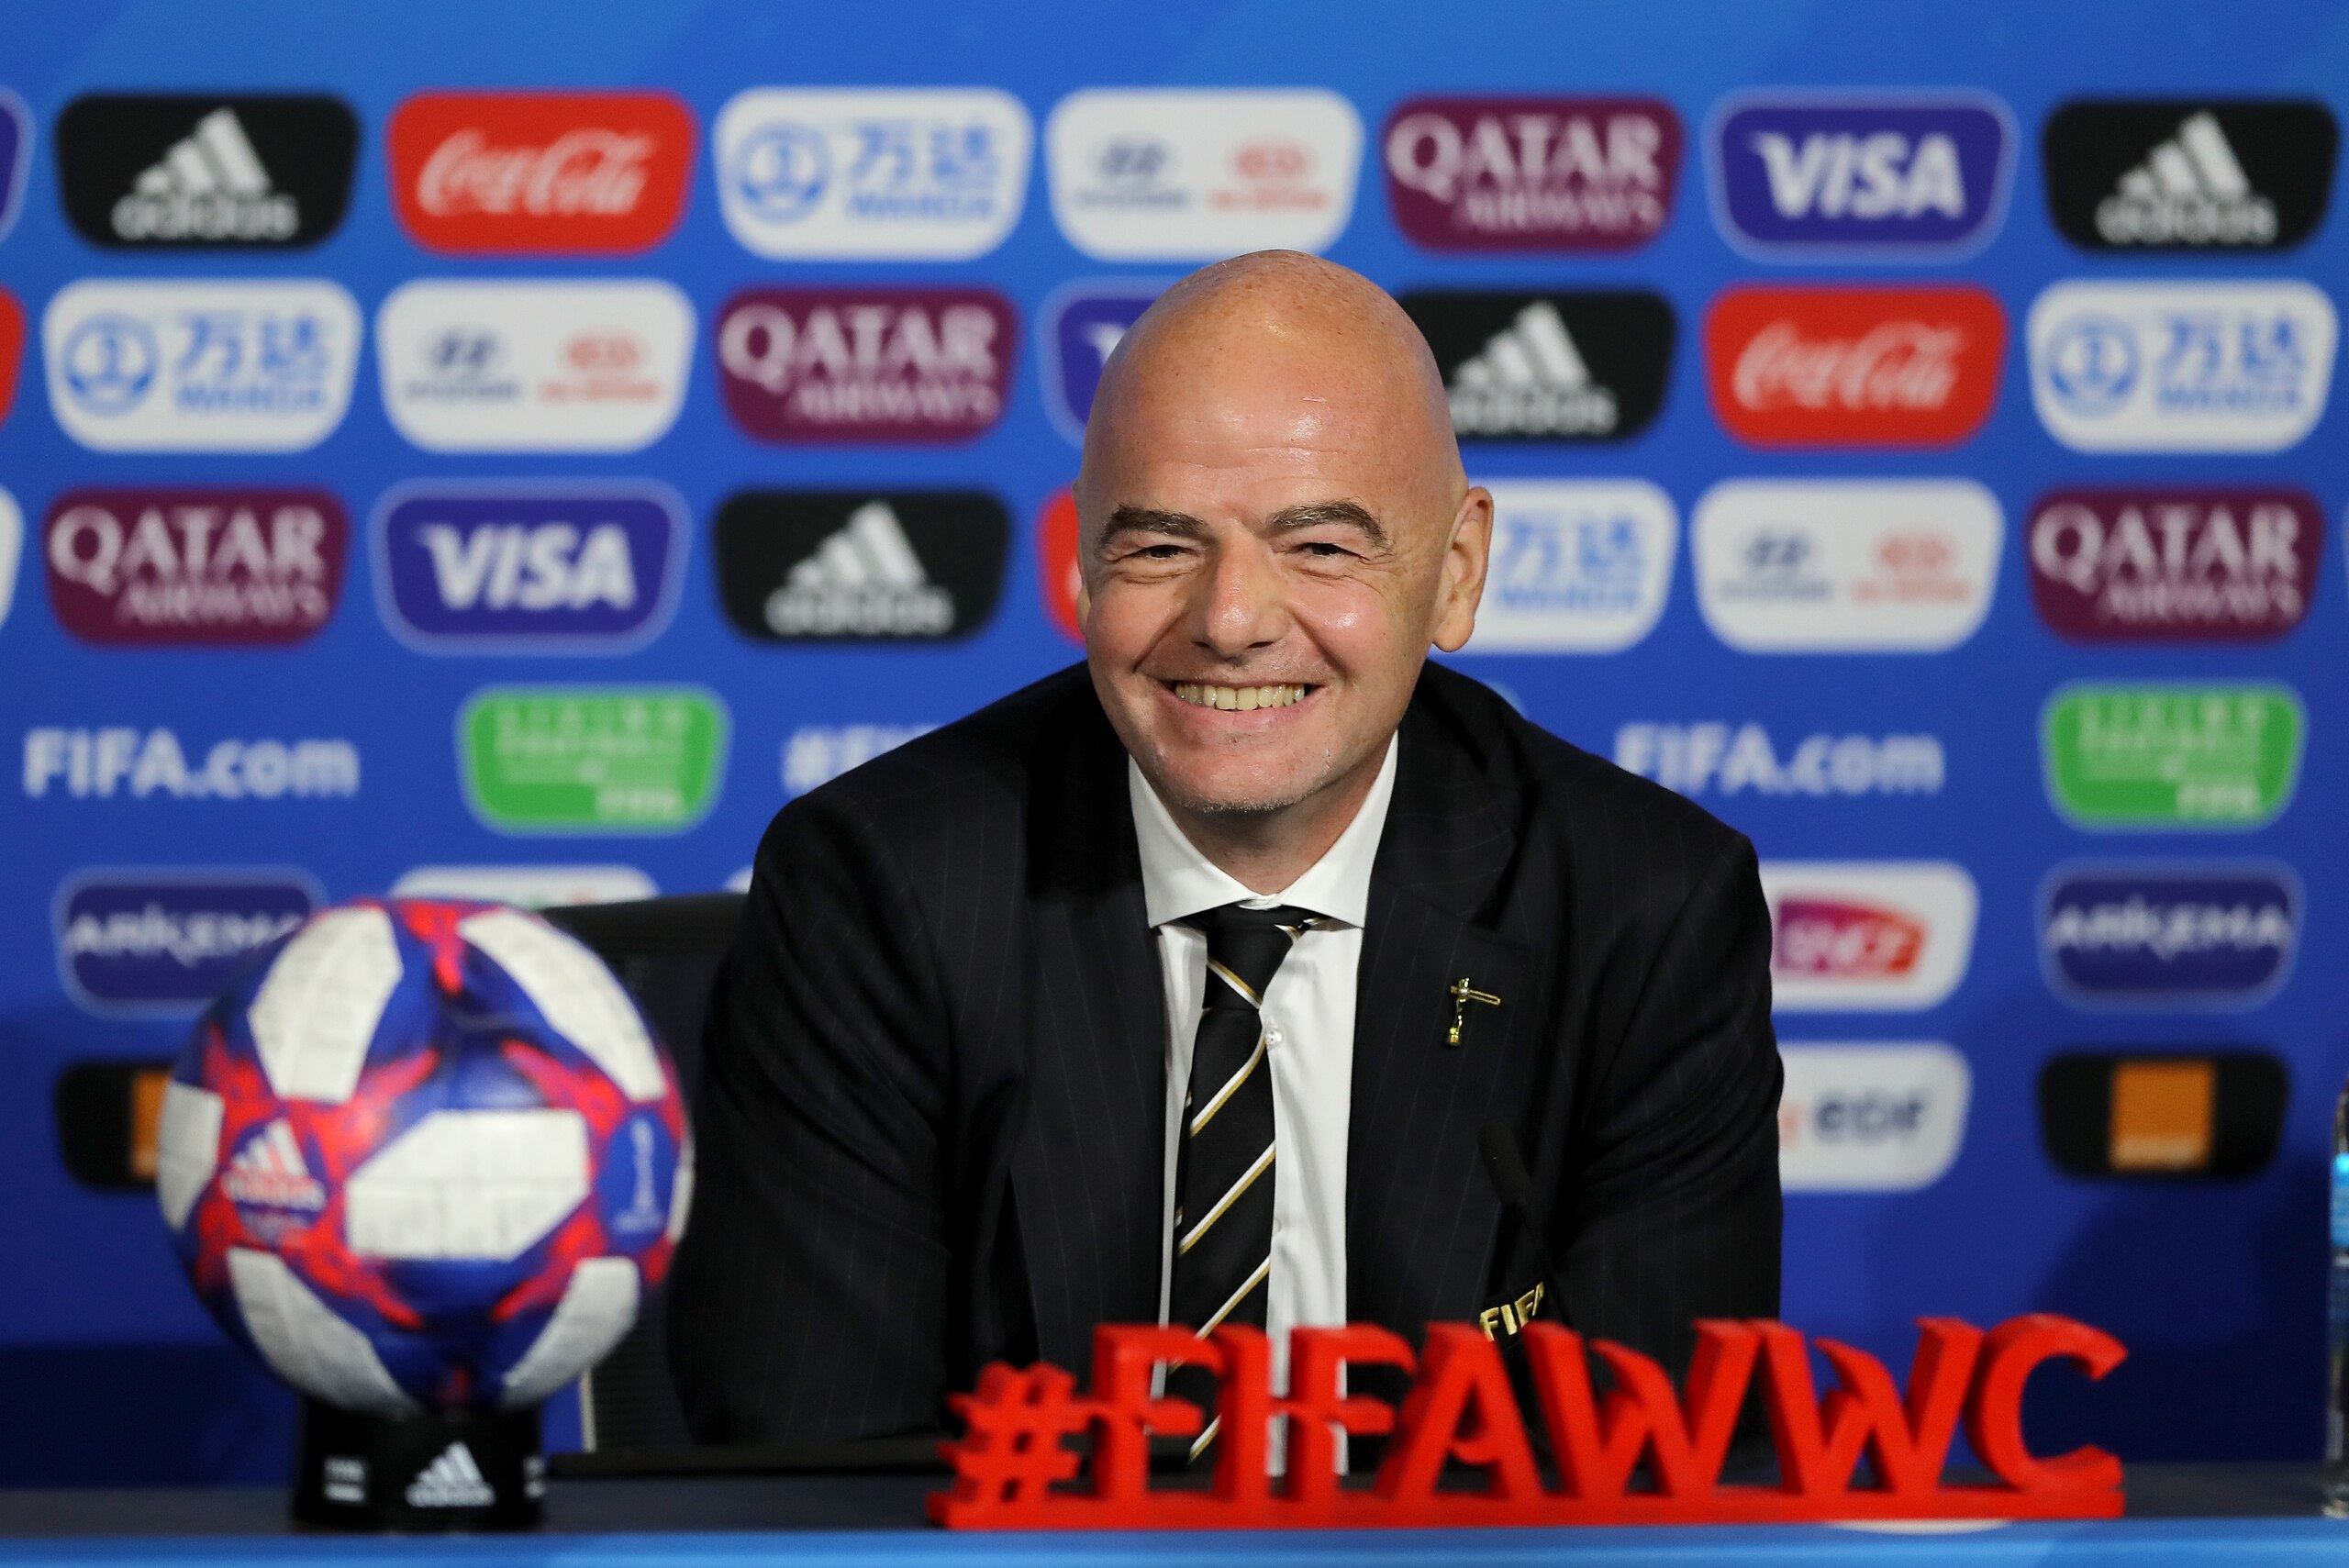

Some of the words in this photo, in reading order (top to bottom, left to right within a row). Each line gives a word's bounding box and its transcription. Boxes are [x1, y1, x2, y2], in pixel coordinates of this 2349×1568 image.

[1388, 113, 1662, 203] QATAR
[1748, 132, 1966, 218] VISA
[112, 191, 298, 239] adidas
[2095, 194, 2277, 244] adidas
[719, 305, 999, 395] QATAR
[49, 506, 327, 595] QATAR
[416, 524, 638, 611] VISA
[2032, 503, 2299, 594] QATAR
[764, 584, 955, 636] adidas
[23, 727, 361, 797] FIFA.com
[1615, 721, 1944, 795] FIFA.com
[936, 1314, 2126, 1516] #FIFAWWC
